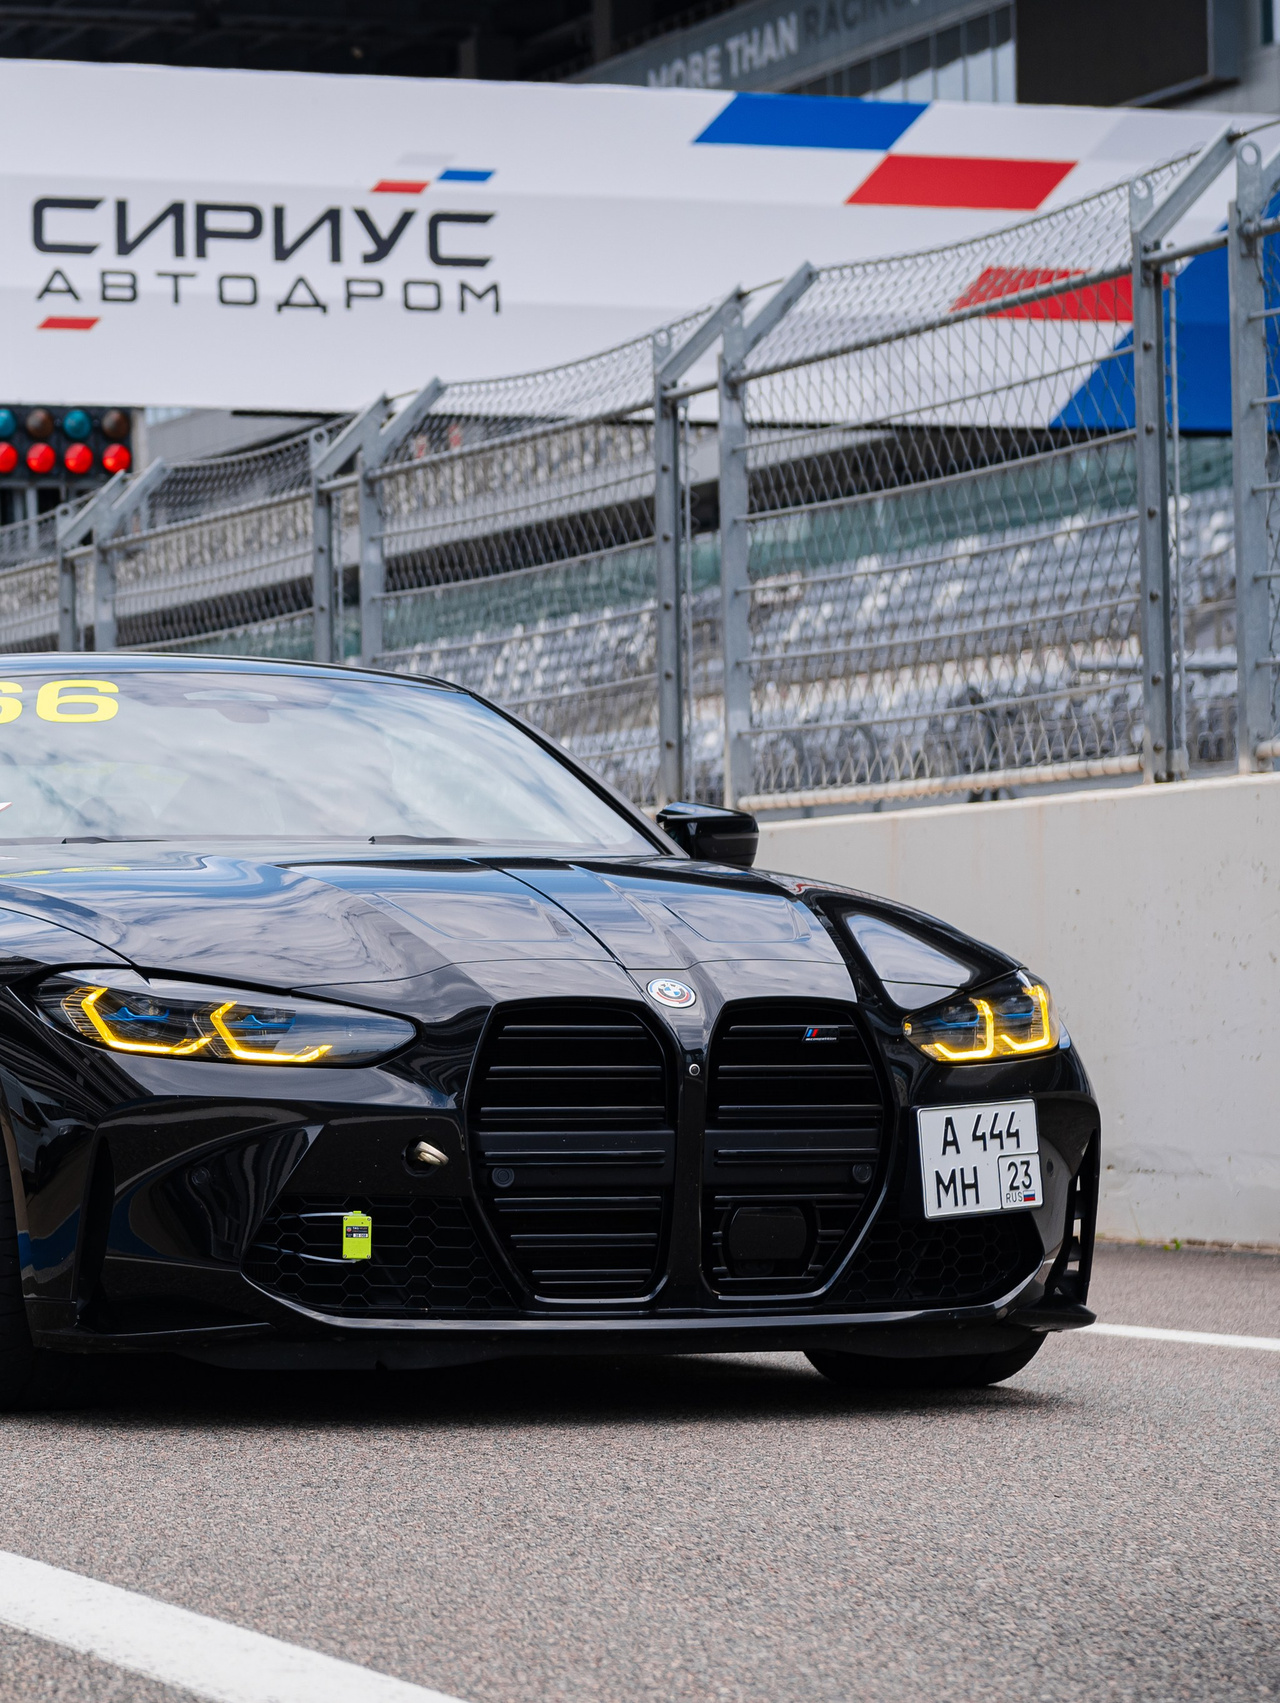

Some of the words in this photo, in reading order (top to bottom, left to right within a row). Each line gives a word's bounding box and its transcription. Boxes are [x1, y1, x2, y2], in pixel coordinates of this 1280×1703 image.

[725, 11, 799, 78] THAN
[33, 197, 496, 267] СИРИУС
[36, 268, 501, 314] АВТОДРОМ
[972, 1111, 1021, 1152] 444
[1006, 1191, 1023, 1203] RUS
[1007, 1160, 1032, 1191] 23
